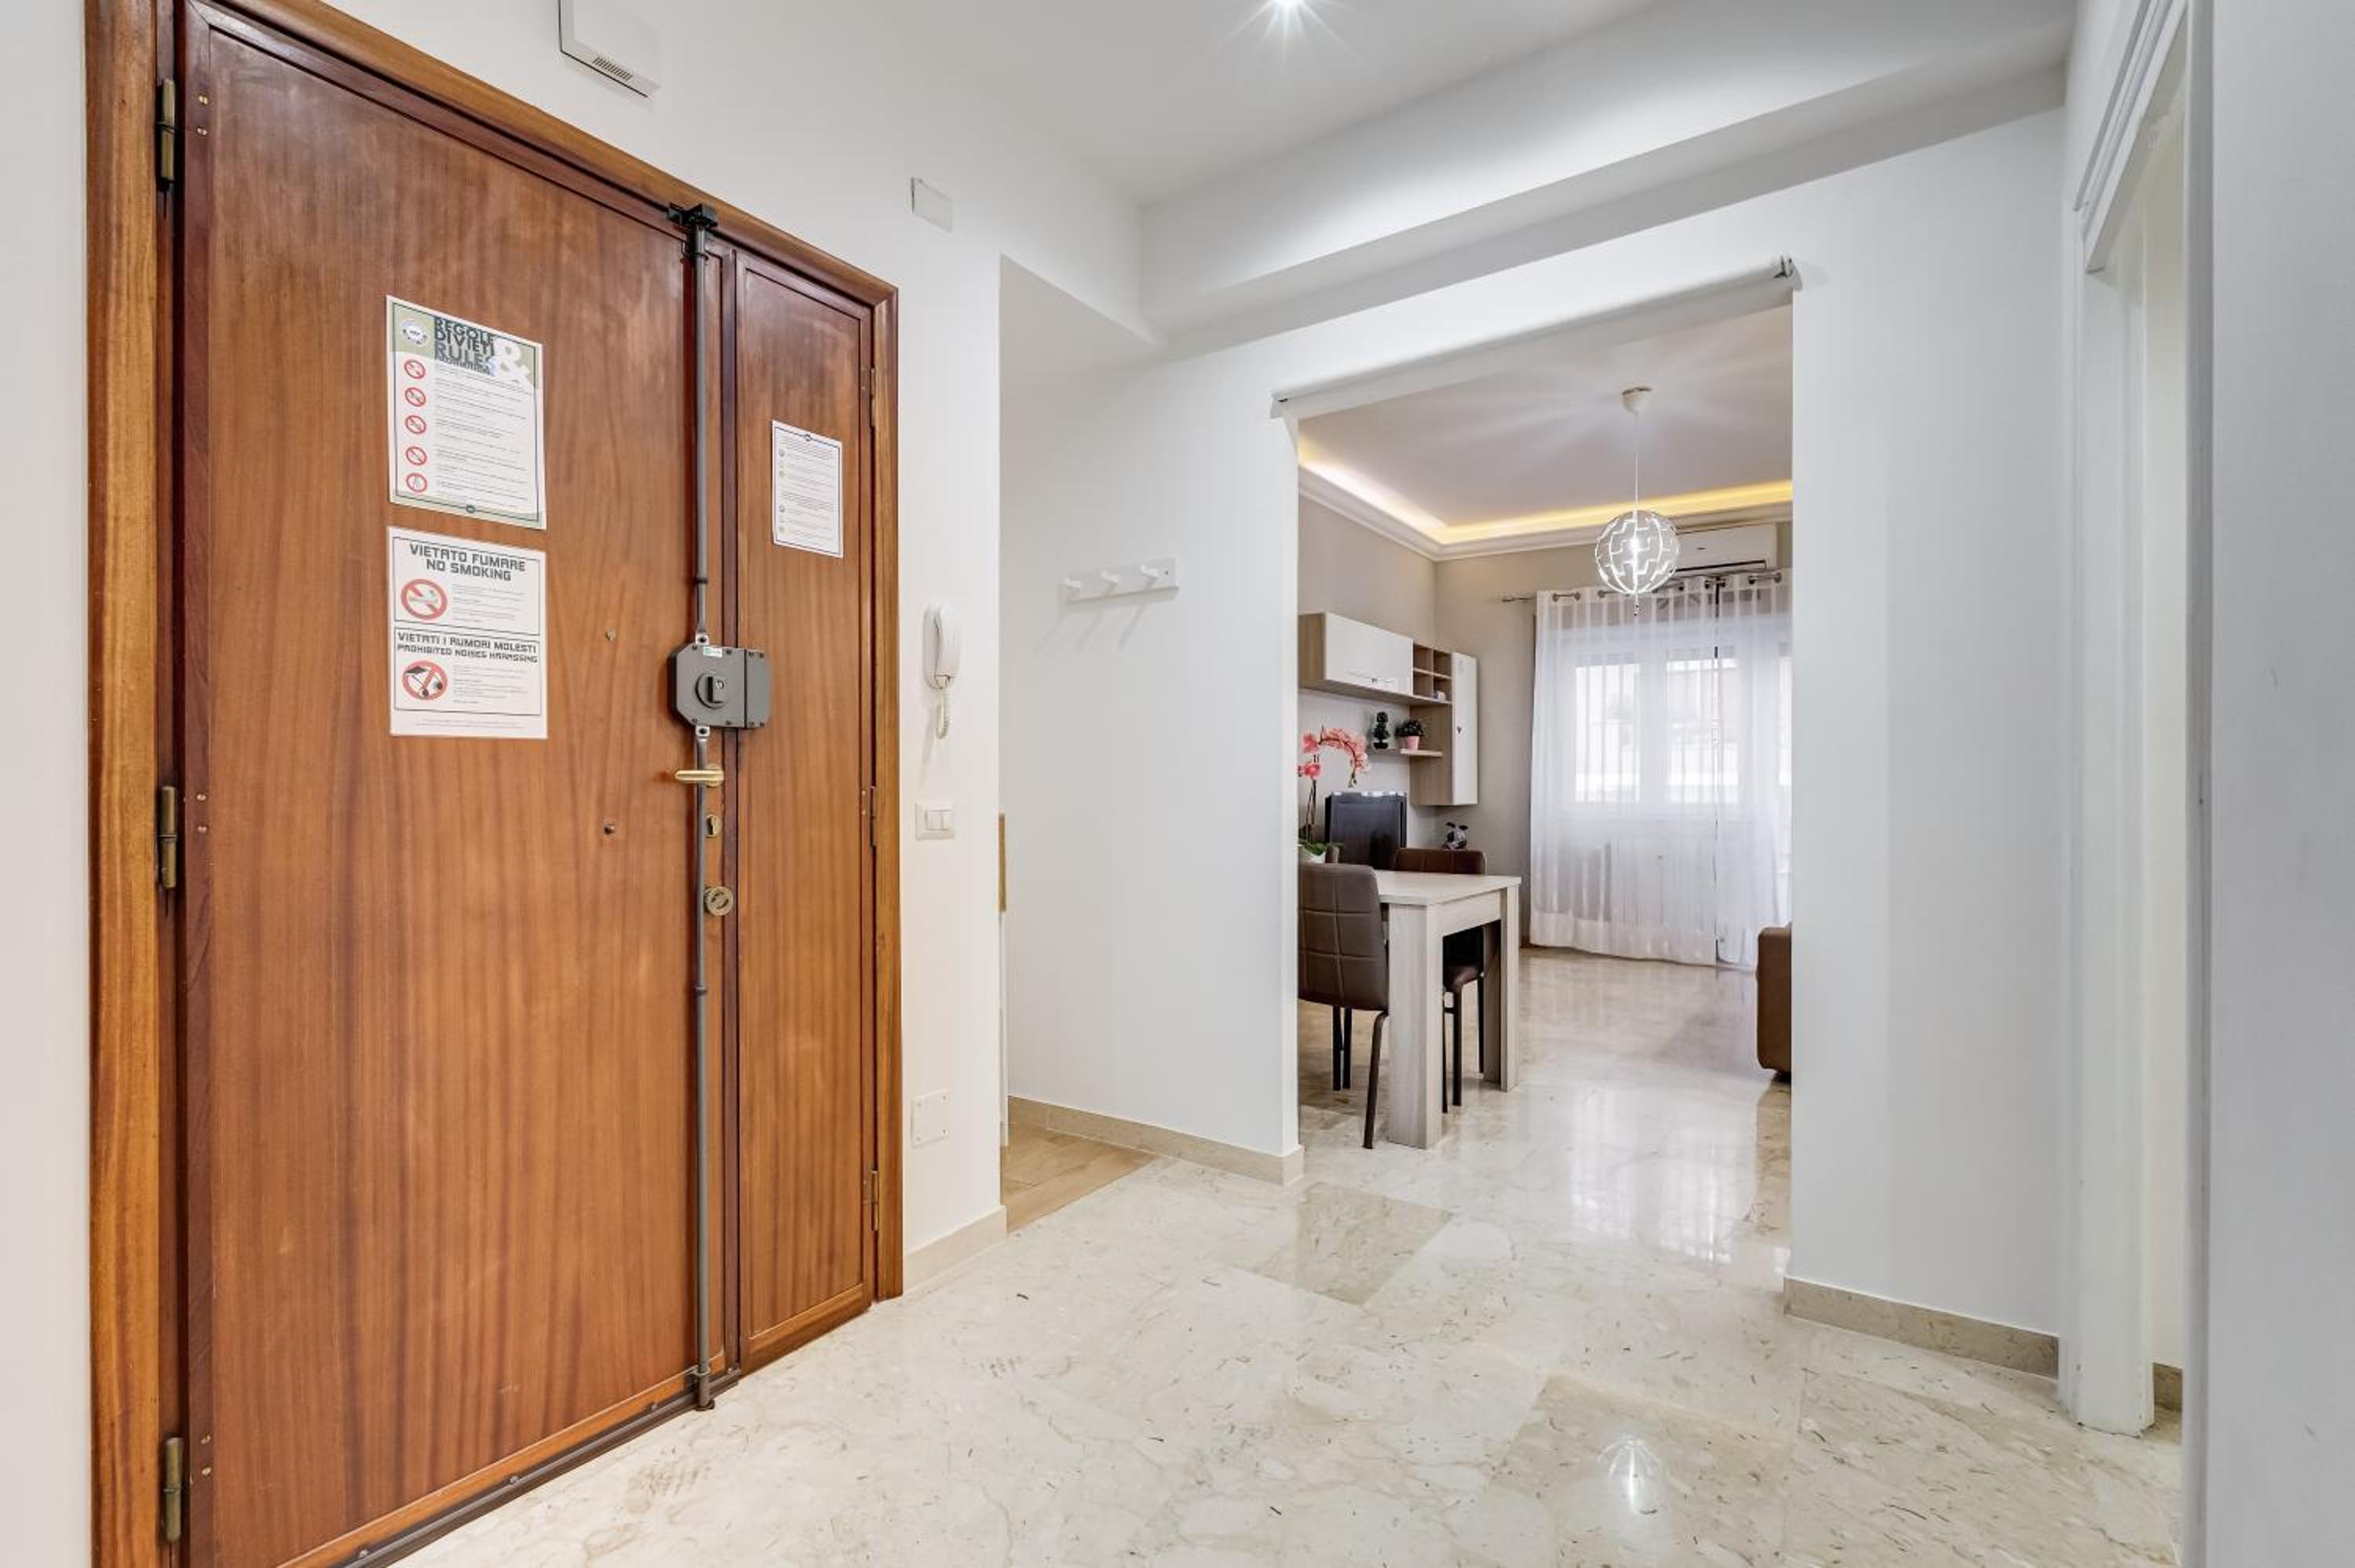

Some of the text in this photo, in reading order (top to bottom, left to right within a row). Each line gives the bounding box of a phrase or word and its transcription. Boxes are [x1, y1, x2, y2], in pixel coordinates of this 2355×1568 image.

[435, 330, 494, 356] DIVIETI
[409, 543, 526, 572] VIETATO FUMARE
[426, 559, 511, 582] NO SMOKING
[397, 632, 440, 644] VIETATI
[450, 636, 491, 649] RUMORI
[494, 642, 537, 653] MOLESTI
